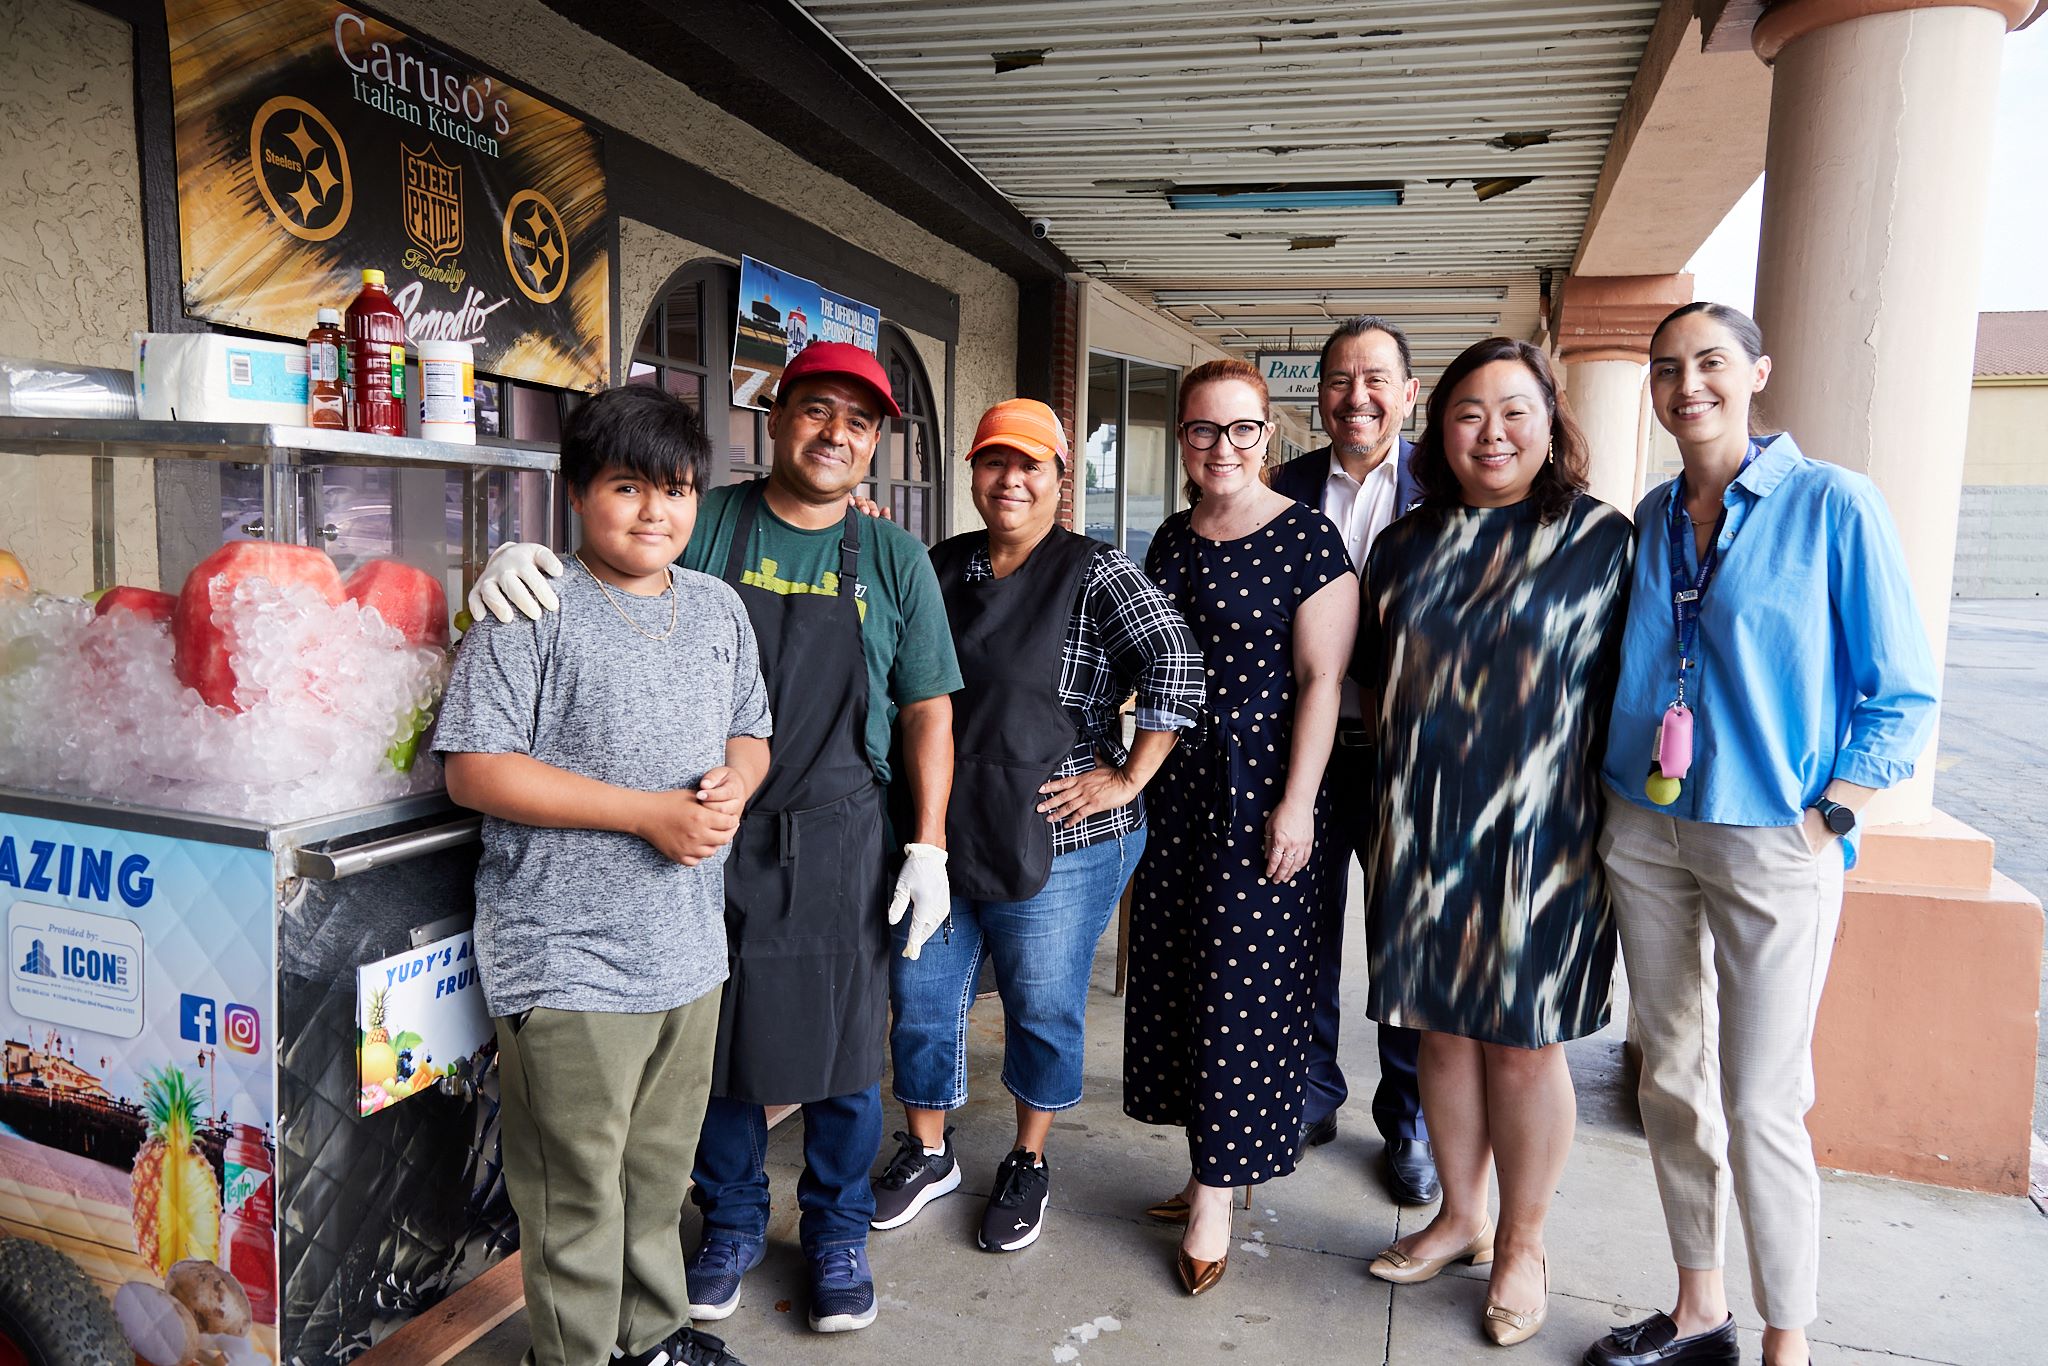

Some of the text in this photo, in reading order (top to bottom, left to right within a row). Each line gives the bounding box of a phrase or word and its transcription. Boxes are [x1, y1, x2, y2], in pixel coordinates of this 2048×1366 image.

[334, 13, 510, 135] Caruso's
[351, 72, 500, 158] Italian Kitchen
[265, 148, 302, 173] Steelers
[407, 156, 458, 200] STEEL
[408, 189, 457, 248] PRIDE
[512, 232, 536, 249] Steelers
[402, 248, 466, 293] Family
[820, 297, 876, 334] THE OFFICIAL BEER
[822, 318, 854, 344] SPONSOR
[1267, 360, 1312, 379] PARK
[1286, 385, 1293, 393] A
[1295, 384, 1316, 393] Real
[48, 923, 99, 942] Provided by:
[63, 945, 117, 985] ICON
[117, 956, 128, 986] CDC
[386, 940, 475, 989] YUDY'S A
